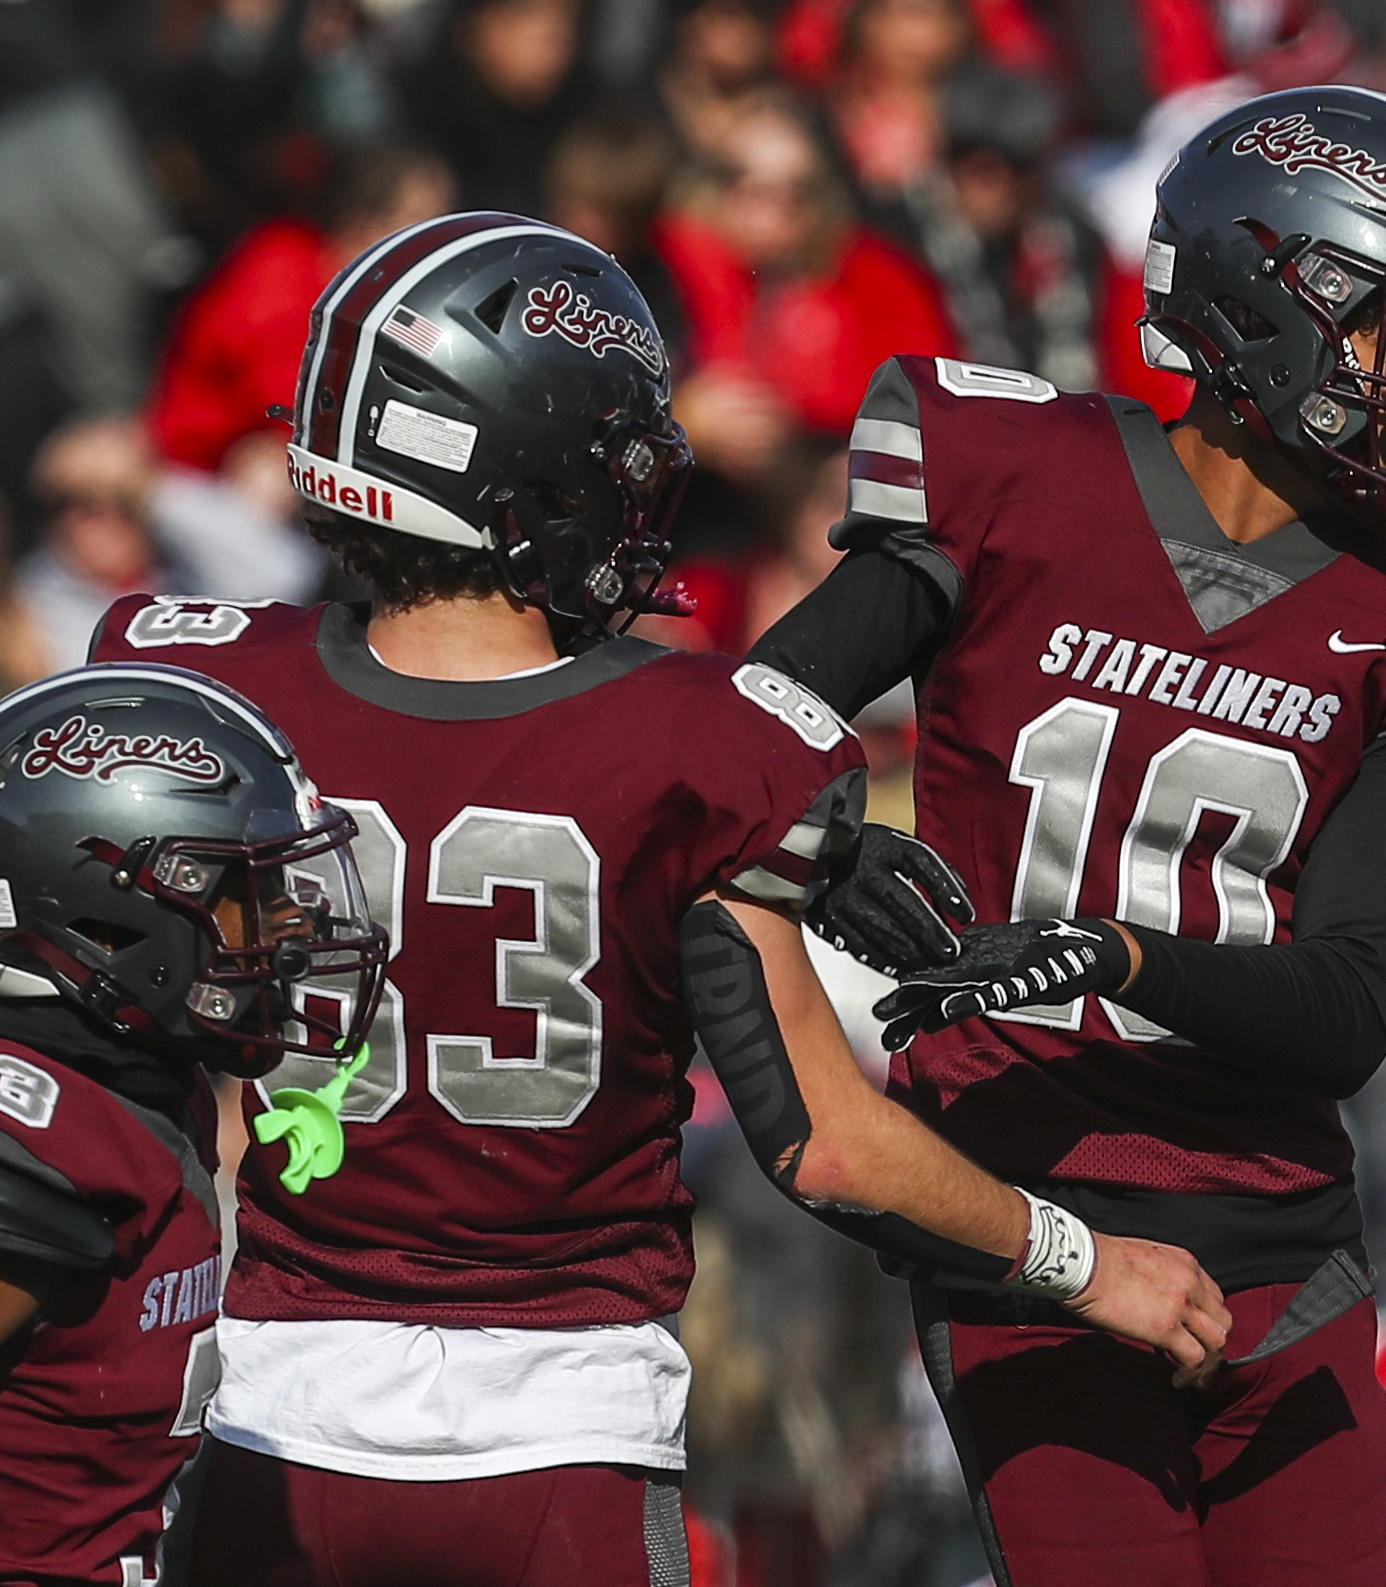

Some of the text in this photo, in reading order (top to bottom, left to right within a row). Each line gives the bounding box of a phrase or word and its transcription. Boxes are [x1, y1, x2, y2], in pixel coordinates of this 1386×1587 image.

[521, 280, 668, 376] Liners
[287, 451, 392, 521] Riddell
[124, 598, 258, 649] 3
[730, 662, 847, 752] 8
[1038, 623, 1342, 744] STATELINERS
[21, 715, 225, 785] Liners
[985, 697, 1310, 1046] 10
